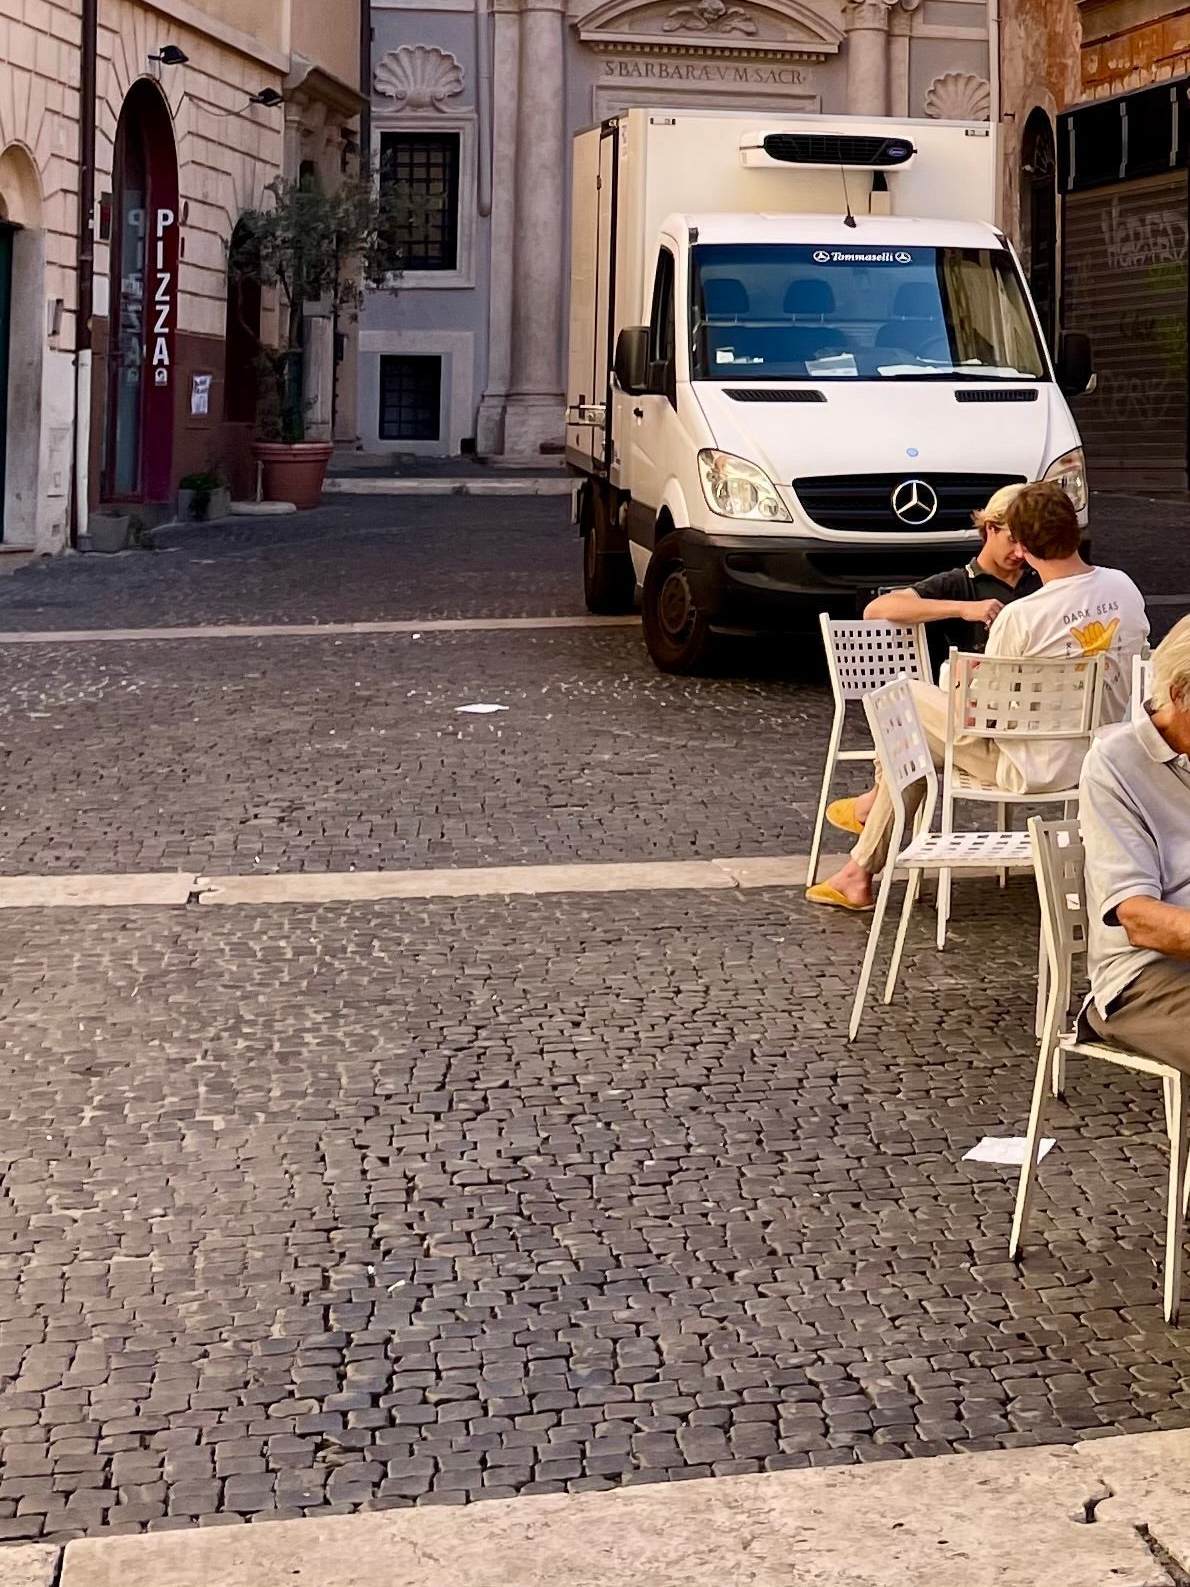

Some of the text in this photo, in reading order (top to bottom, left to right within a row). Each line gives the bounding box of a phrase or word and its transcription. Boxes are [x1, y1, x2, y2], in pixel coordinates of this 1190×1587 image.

[830, 251, 894, 262] Tommaselli
[152, 208, 174, 365] PIZZA
[1063, 600, 1119, 625] DARK SEAS
